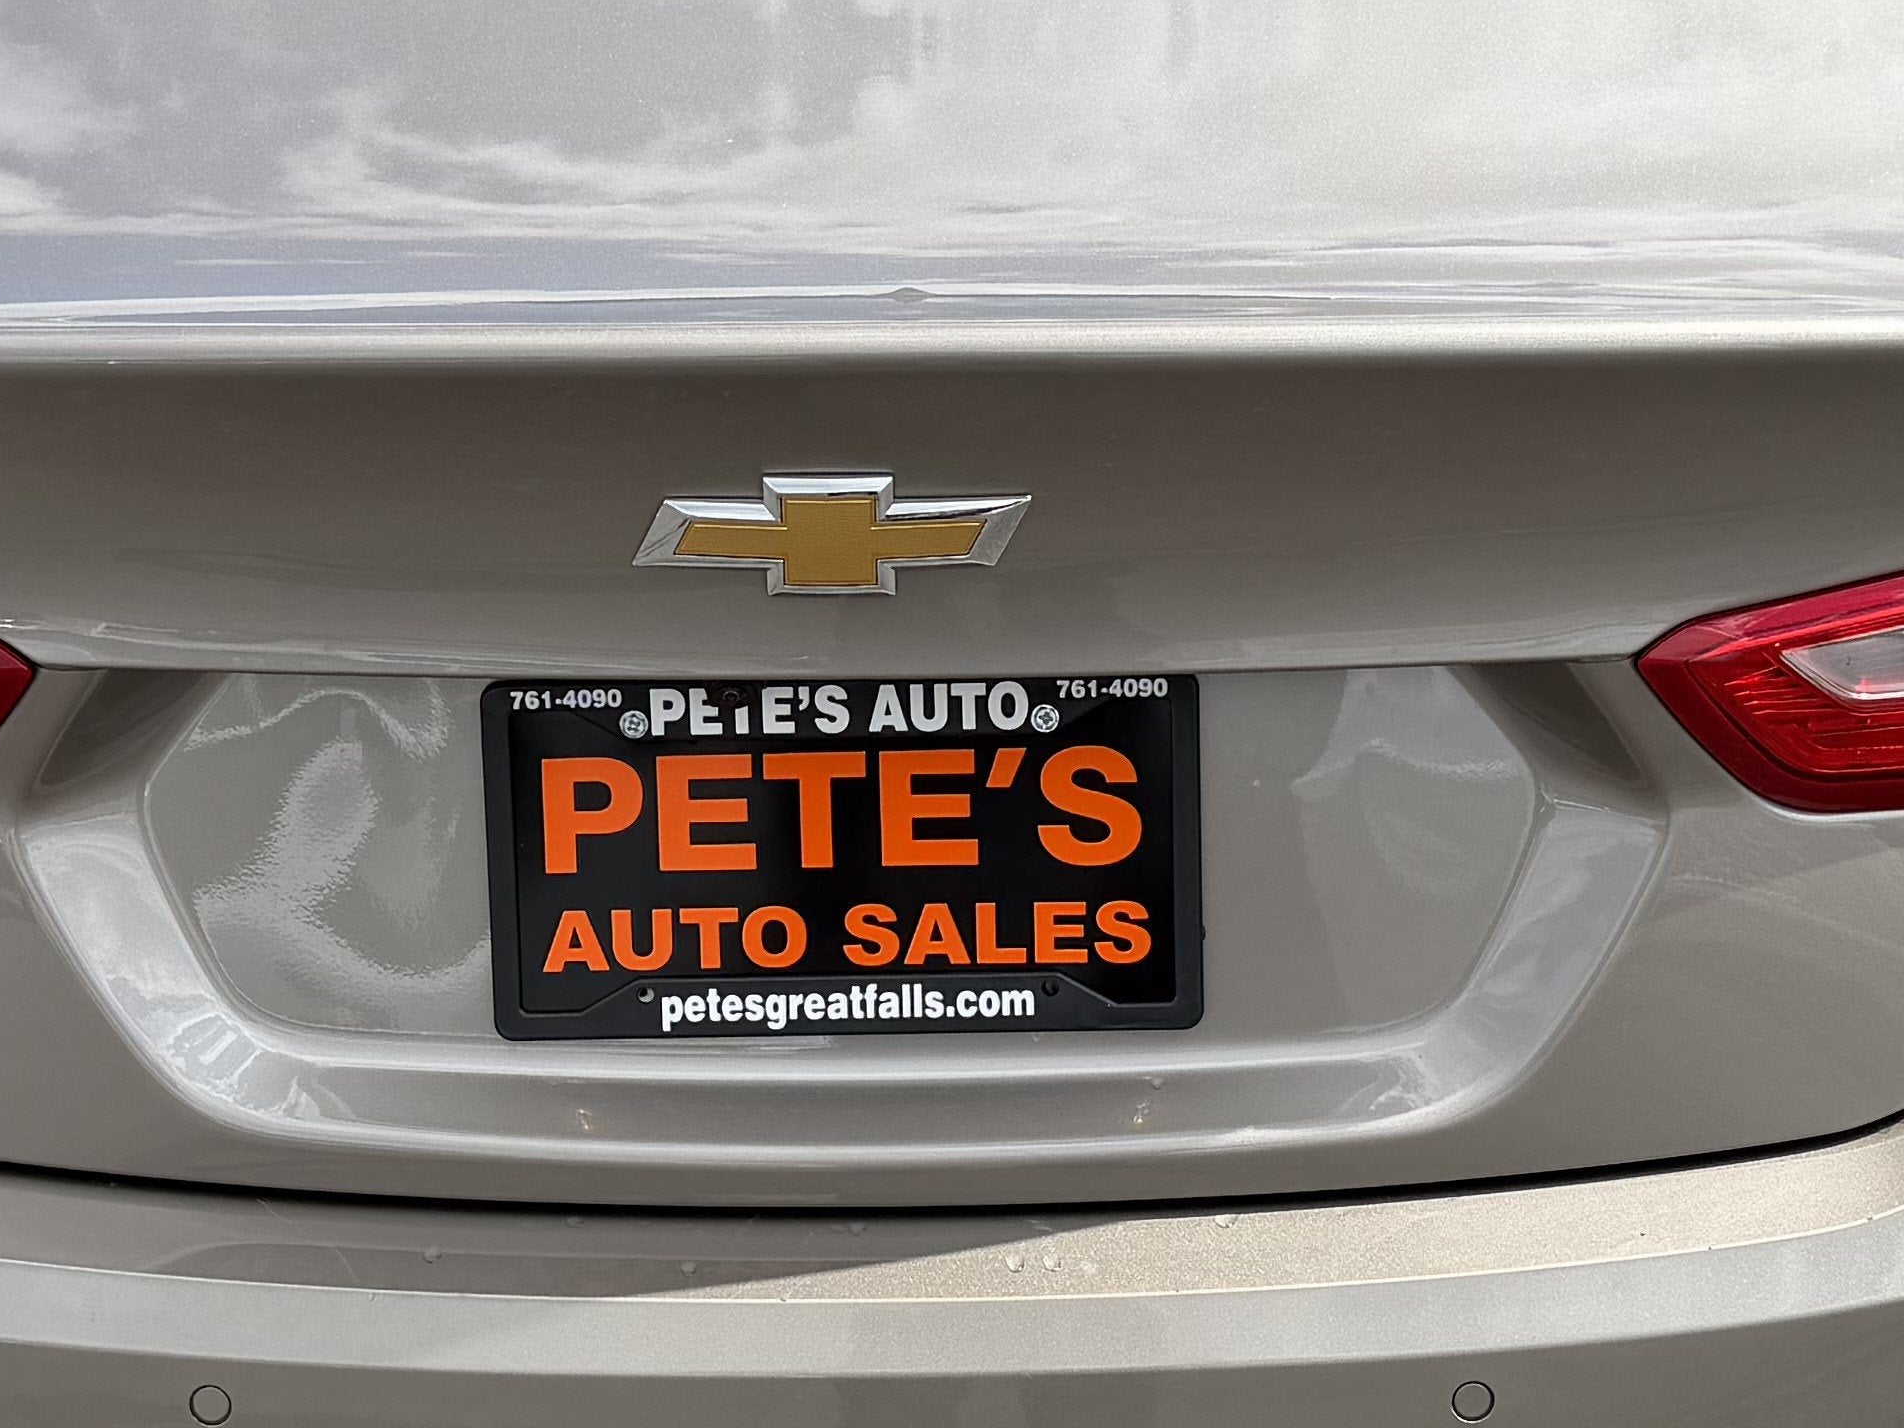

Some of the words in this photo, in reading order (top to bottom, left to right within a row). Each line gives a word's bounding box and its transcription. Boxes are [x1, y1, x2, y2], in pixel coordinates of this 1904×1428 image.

[509, 689, 622, 710] 761-4090
[868, 681, 1029, 733] AUTO
[1056, 678, 1168, 699] 761-4090
[541, 745, 1142, 874] PETE'S
[543, 905, 807, 973] AUTO
[843, 900, 1152, 967] SALES
[660, 983, 1035, 1032] petesgreatfalls.com
